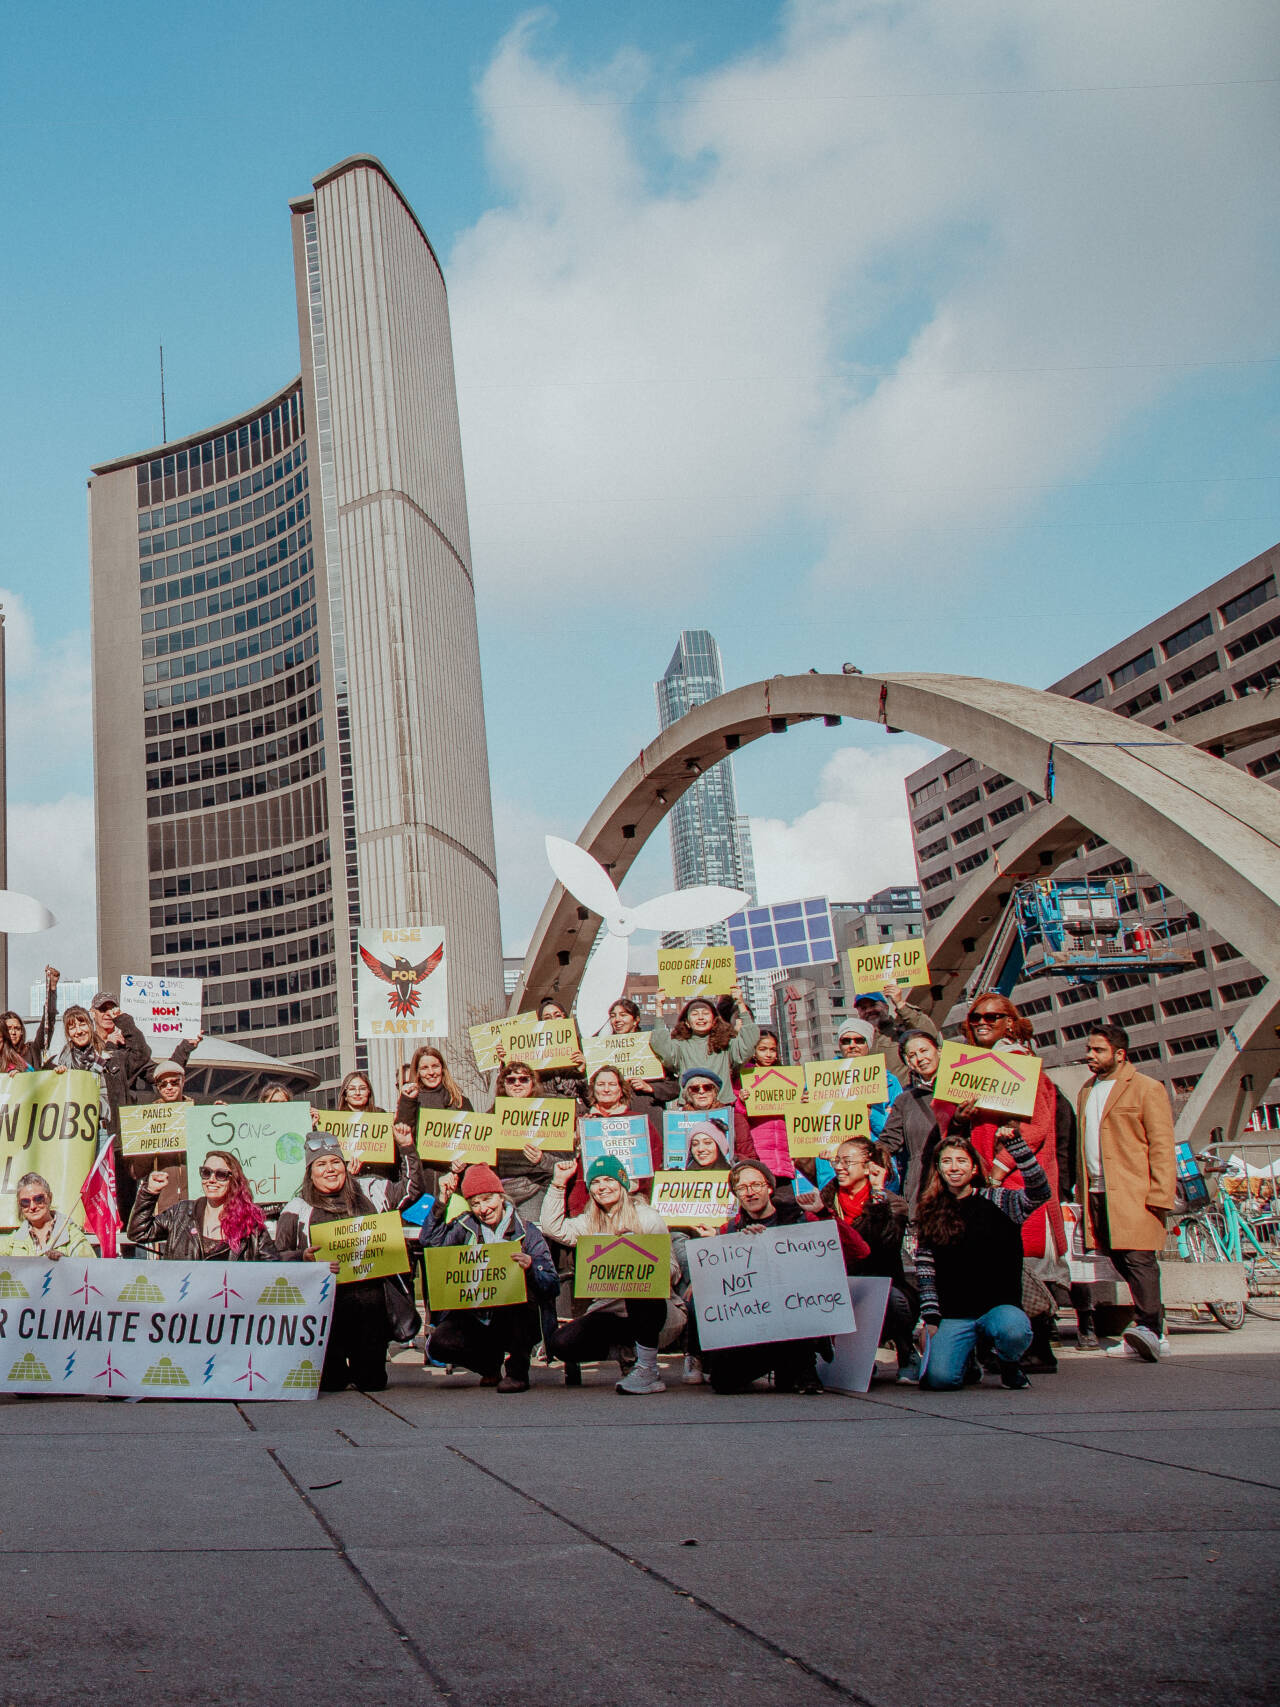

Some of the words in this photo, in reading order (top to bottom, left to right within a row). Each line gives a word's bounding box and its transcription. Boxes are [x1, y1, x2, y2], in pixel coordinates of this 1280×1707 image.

[660, 960, 682, 970] GOOD
[684, 958, 711, 970] GREEN
[712, 958, 732, 970] JOBS
[857, 953, 901, 974] POWER
[904, 950, 920, 966] UP
[392, 969, 418, 981] FOR
[681, 975, 697, 984] FOR
[698, 974, 712, 984] ALL
[152, 1005, 179, 1016] NOW!
[152, 1022, 182, 1032] NOW!
[371, 1019, 436, 1034] EARTH
[510, 1034, 552, 1050] POWER
[556, 1030, 572, 1044] UP
[605, 1038, 635, 1048] PANELS
[510, 1052, 540, 1062] ENERGY
[615, 1052, 630, 1062] NOT
[620, 1066, 645, 1077] LINES
[814, 1069, 860, 1086] POWER
[864, 1066, 880, 1081] UP
[951, 1071, 998, 1094] POWER
[1002, 1081, 1020, 1096] UP
[754, 1090, 784, 1102] POWER
[786, 1088, 797, 1100] UP
[814, 1089, 844, 1100] ENERGY
[947, 1087, 980, 1101] HOUSING
[142, 1108, 172, 1120] PANELS
[502, 1110, 550, 1126] POWER
[552, 1112, 570, 1127] UP
[22, 1103, 98, 1150] JOBS
[150, 1122, 167, 1134] NOT
[206, 1112, 276, 1146] Save
[324, 1122, 368, 1139] POWER
[372, 1124, 388, 1139] UP
[602, 1122, 630, 1130] GOOD
[793, 1115, 840, 1133] POWER
[844, 1114, 863, 1130] UP
[424, 1121, 472, 1140] POWER
[474, 1126, 492, 1142] UP
[140, 1137, 180, 1150] PIPELINES
[605, 1138, 636, 1146] GREEN
[660, 1182, 713, 1198] POWER
[656, 1202, 694, 1214] TRANSIT
[334, 1221, 376, 1236] INDIGENOUS
[328, 1236, 370, 1250] LEADERSHIP
[372, 1232, 387, 1244] AND
[336, 1247, 384, 1263] SOVEREIGNTY
[458, 1250, 488, 1264] MAKE
[696, 1246, 753, 1268] Policy
[446, 1267, 507, 1284] POLLUTERS
[589, 1264, 634, 1280] POWER
[637, 1264, 655, 1280] UP
[460, 1288, 480, 1302] PAY
[481, 1286, 498, 1300] UP
[586, 1283, 618, 1292] HOUSING
[620, 1283, 652, 1292] JUSTICE!
[784, 1292, 846, 1313] Change
[18, 1310, 138, 1344] CLIMATE
[148, 1312, 328, 1348] SOLUTIONS!
